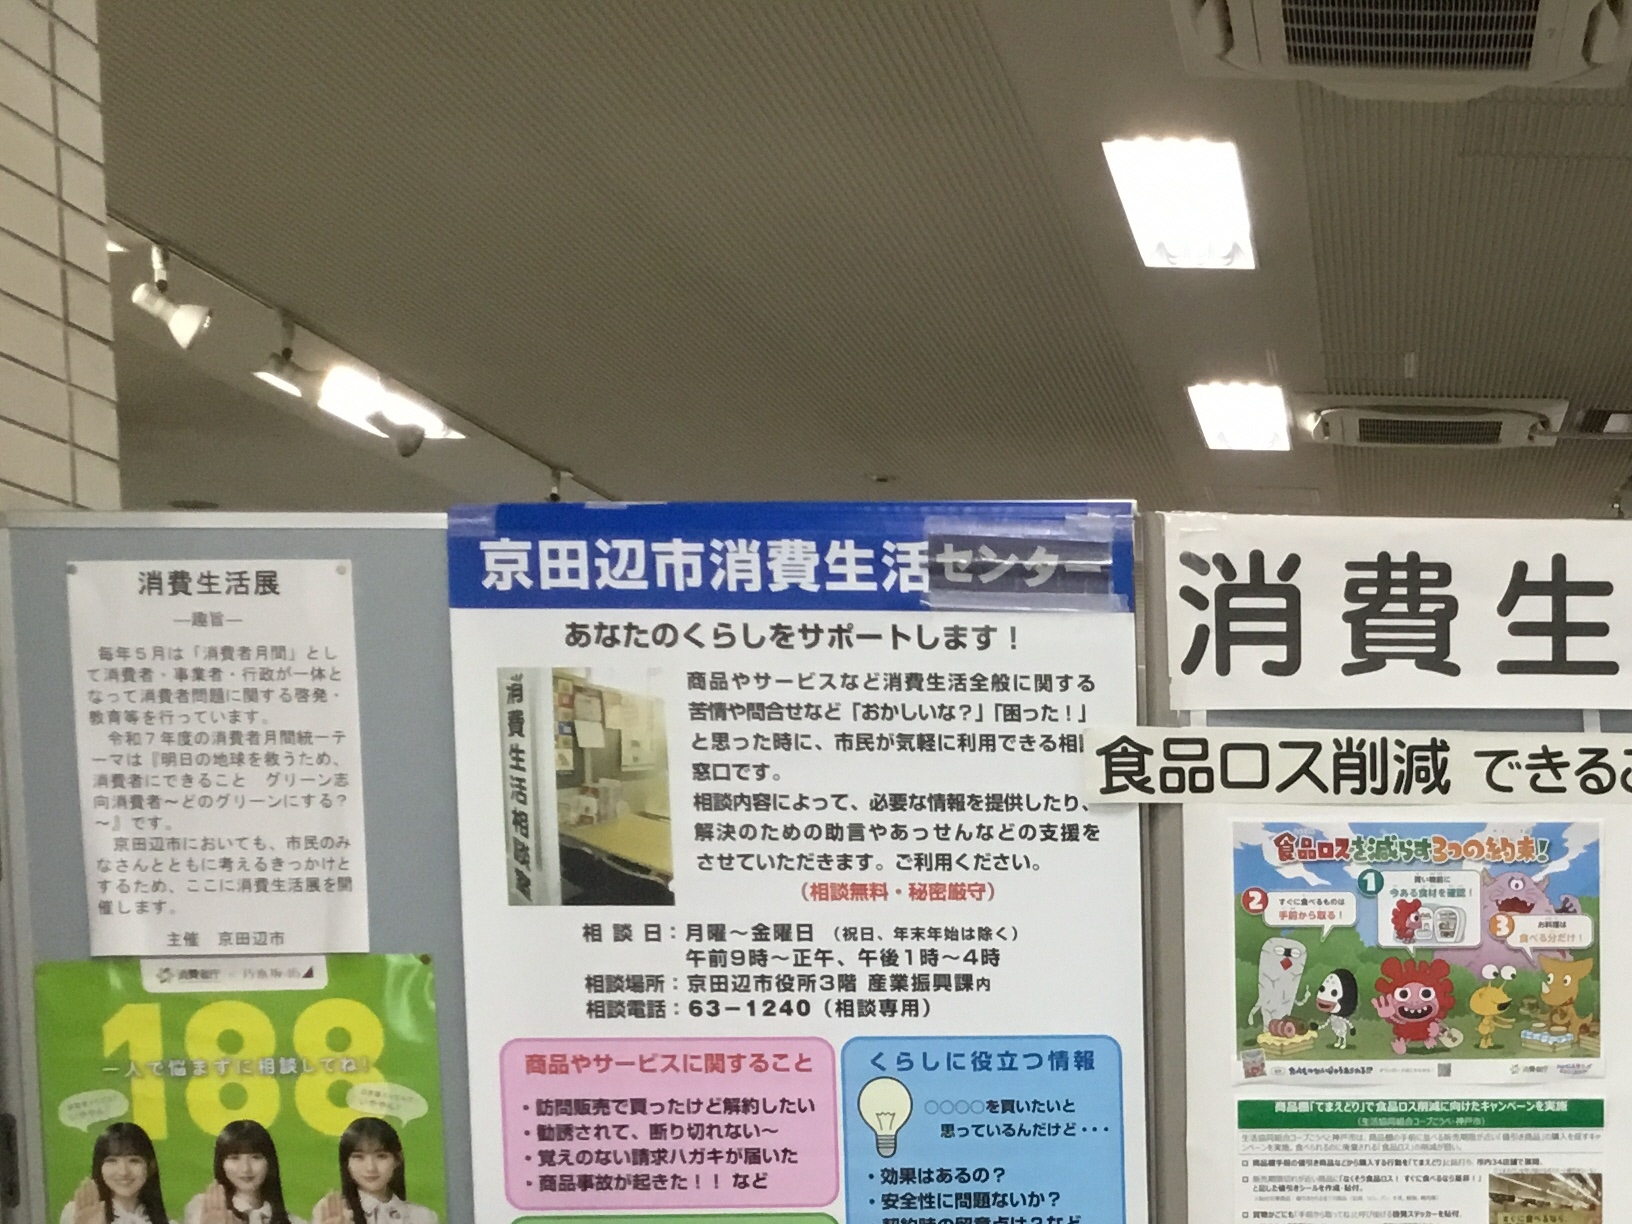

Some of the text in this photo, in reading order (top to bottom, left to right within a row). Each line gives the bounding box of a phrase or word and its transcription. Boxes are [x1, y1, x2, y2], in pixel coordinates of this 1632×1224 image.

[479, 538, 1103, 593] 京田辺市消費生活センター
[138, 570, 281, 596] 消費生活展
[564, 620, 1019, 651] あなたのくらしをサポートします！
[98, 646, 338, 662] 毎年５月は「消費者月間」とし
[87, 667, 342, 683] て消費者・事業者・行政が一体と
[687, 672, 1096, 694] 商品やサービスなど消費生活全般に関する
[88, 688, 340, 704] なって消費者問題に関する啓発・
[89, 710, 270, 726] 教育等を行っています。
[688, 702, 1090, 724] 苦情や問合せなど「おかしいな？」「困った！」
[108, 730, 346, 746] 令和７年度の消費者月間統一テ
[691, 731, 1084, 754] と思った時に、市民が気軽に利用できる相
[691, 761, 782, 782] 窓口です。
[1094, 735, 1452, 797] 食品ロス削減
[93, 773, 349, 788] 消費者にできること グリーン志
[693, 791, 1090, 813] 相談内容によって、必要な情報を提供したり、
[694, 821, 1100, 843] 解決のための助言やあっせんなどの支援を
[113, 836, 351, 852] 京田辺市においても、市民のみ
[1273, 832, 1550, 863] 食品ロスを減らす3つの約束！
[97, 857, 350, 872] なさんとともに考えるきっかけと
[696, 852, 1042, 872] させていただきます。ご利用ください。
[97, 877, 352, 893] するため、ここに消費生活展を開
[800, 881, 996, 902] （相談無料・秘密厳守）
[1363, 873, 1377, 891] 1
[98, 900, 177, 915] 催します。
[1248, 892, 1264, 910] 2
[1278, 897, 1345, 906] すぐに食べるものは
[1278, 910, 1343, 921] 手前から取る！
[1494, 918, 1509, 936] 3
[167, 931, 285, 947] 主催 京田辺市
[102, 998, 386, 1139] 188
[525, 1052, 814, 1076] 商品やサービスに関すること
[869, 1049, 1097, 1074] くらしに役立つ情報
